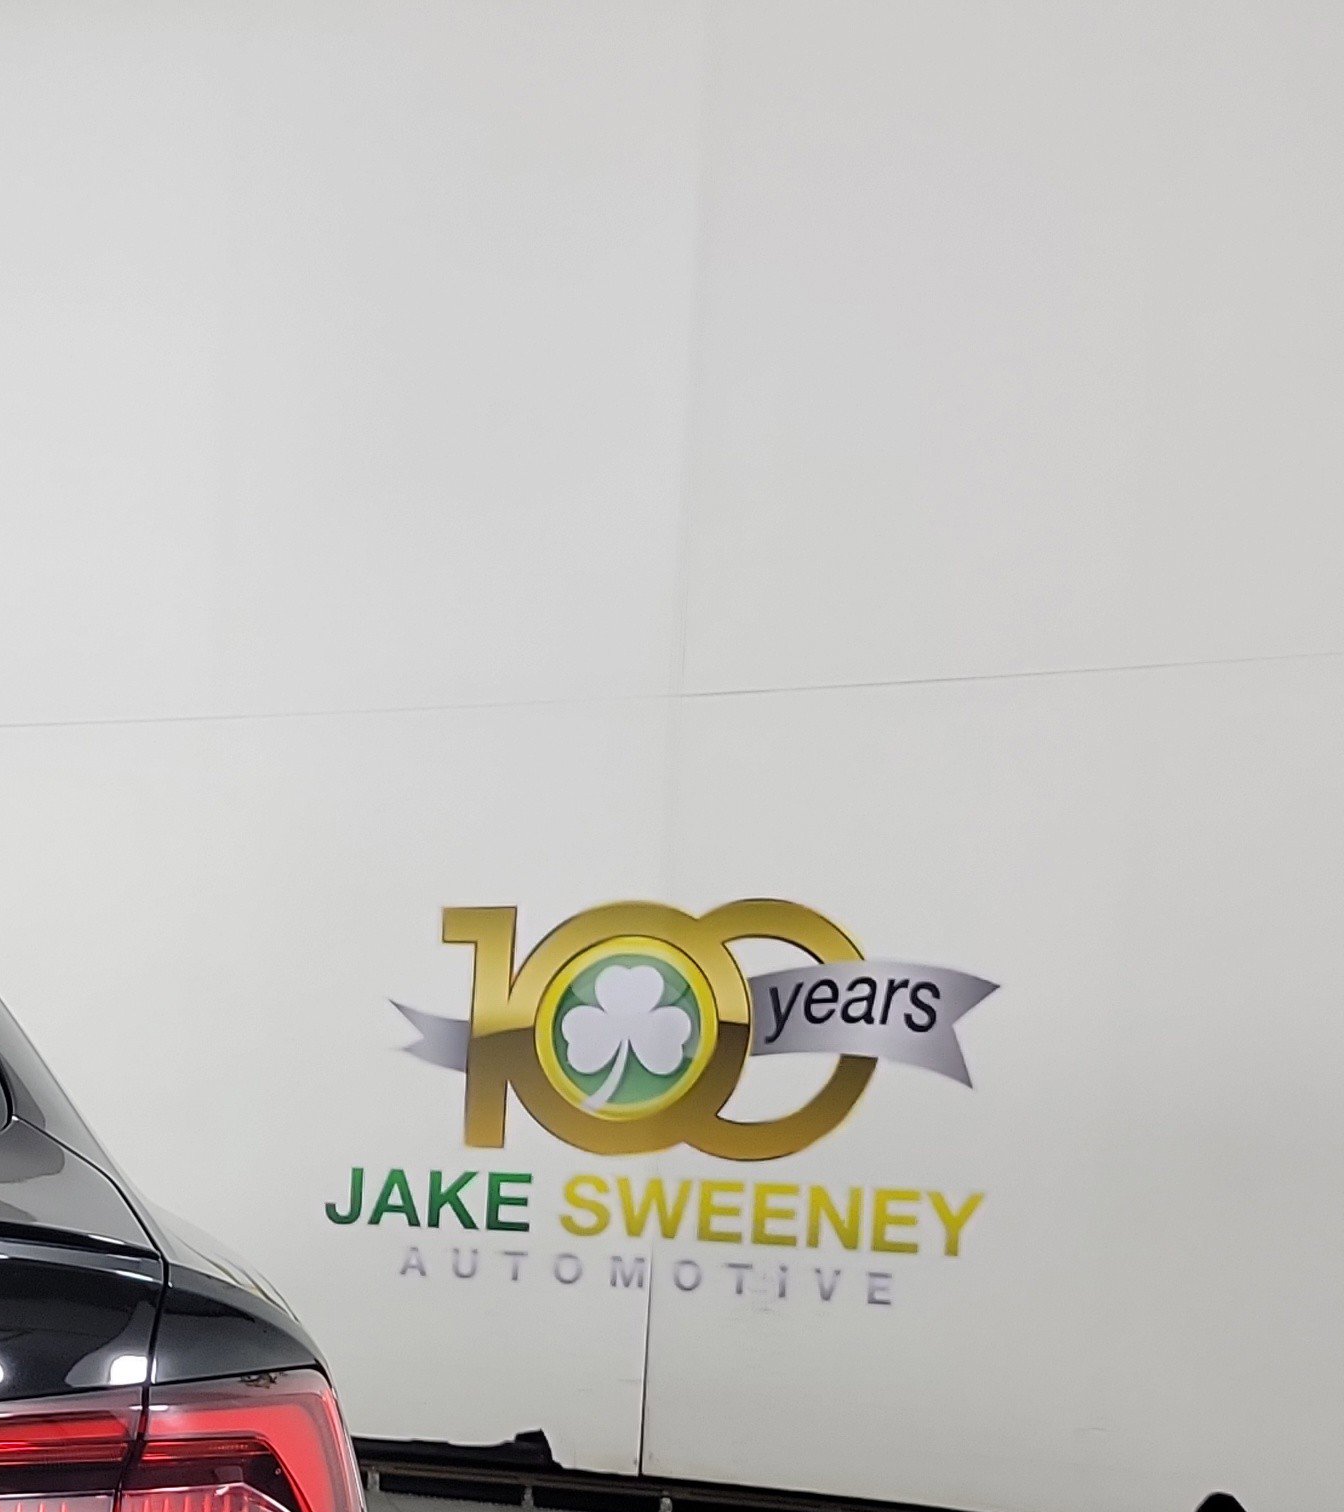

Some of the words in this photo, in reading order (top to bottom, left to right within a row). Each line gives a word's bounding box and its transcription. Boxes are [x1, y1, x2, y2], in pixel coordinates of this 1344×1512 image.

[442, 898, 878, 1161] 100
[764, 977, 941, 1044] years
[325, 1167, 532, 1233] JAKE
[559, 1174, 985, 1257] SWEENEY
[400, 1246, 892, 1306] AUTOMOTIVE
